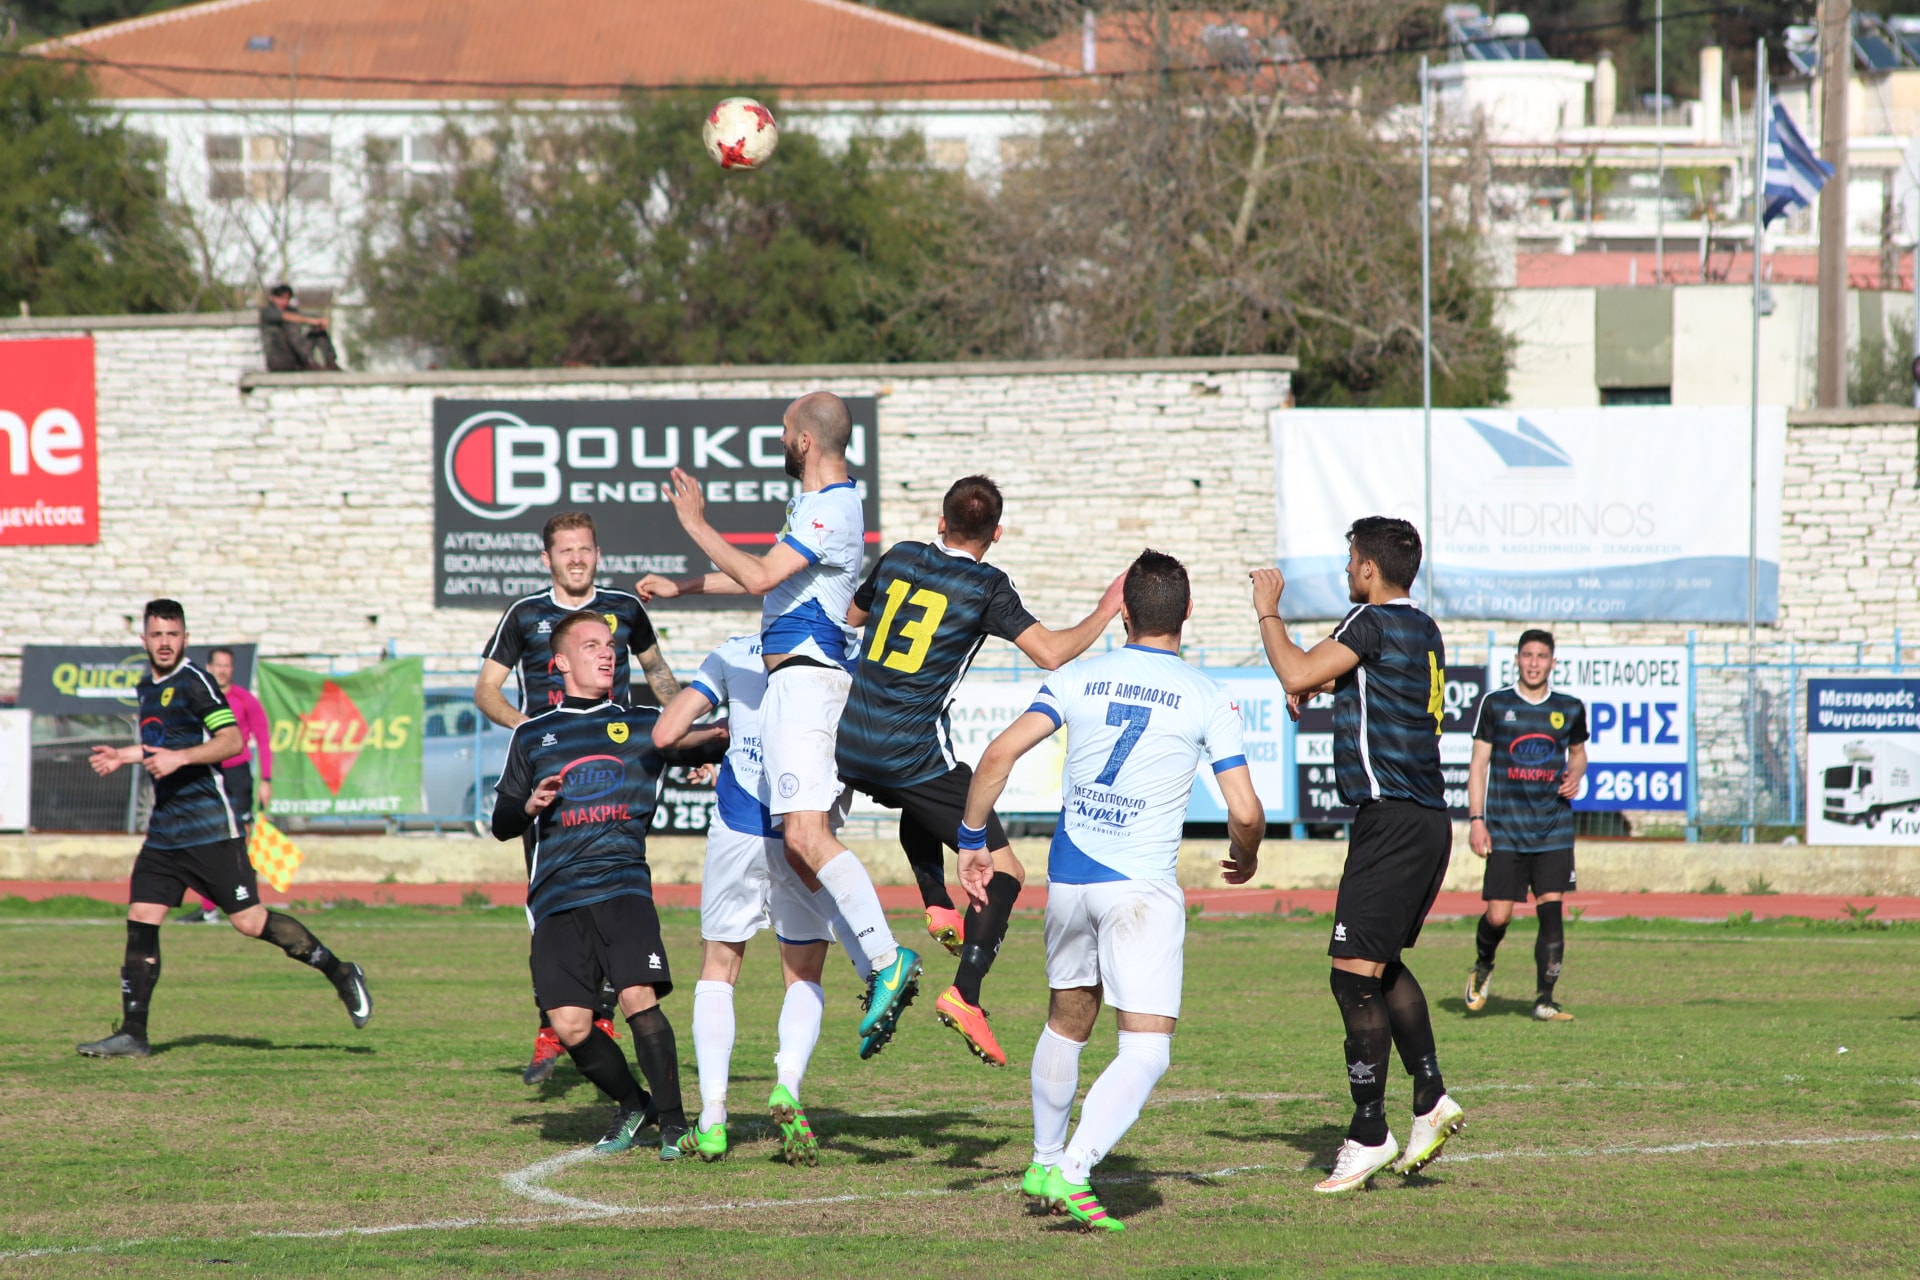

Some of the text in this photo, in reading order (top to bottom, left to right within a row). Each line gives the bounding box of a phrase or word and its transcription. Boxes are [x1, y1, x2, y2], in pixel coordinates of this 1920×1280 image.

[1393, 500, 1656, 538] HANDRINOS
[867, 579, 948, 674] 13
[1578, 659, 1680, 687] ΜΕΤΑΦΟΡΕΣ
[1084, 681, 1182, 710] ΝΕΟΣ ΑΜΦΙΛΟΧΟΣ
[1819, 688, 1915, 710] Μεταφορές
[270, 716, 412, 753] DIELLAS
[1590, 702, 1679, 744] ΡΗΣ
[1094, 701, 1153, 787] 7
[567, 767, 618, 786] vitex
[1508, 767, 1556, 782] ΜΑΚΡΗΣ
[1595, 771, 1682, 801] 26161
[270, 796, 401, 814] ΣΟΥΠΕΡ ΜΑΡΚΕΤ
[561, 803, 632, 828] ΜΑΚΡΗΣ
